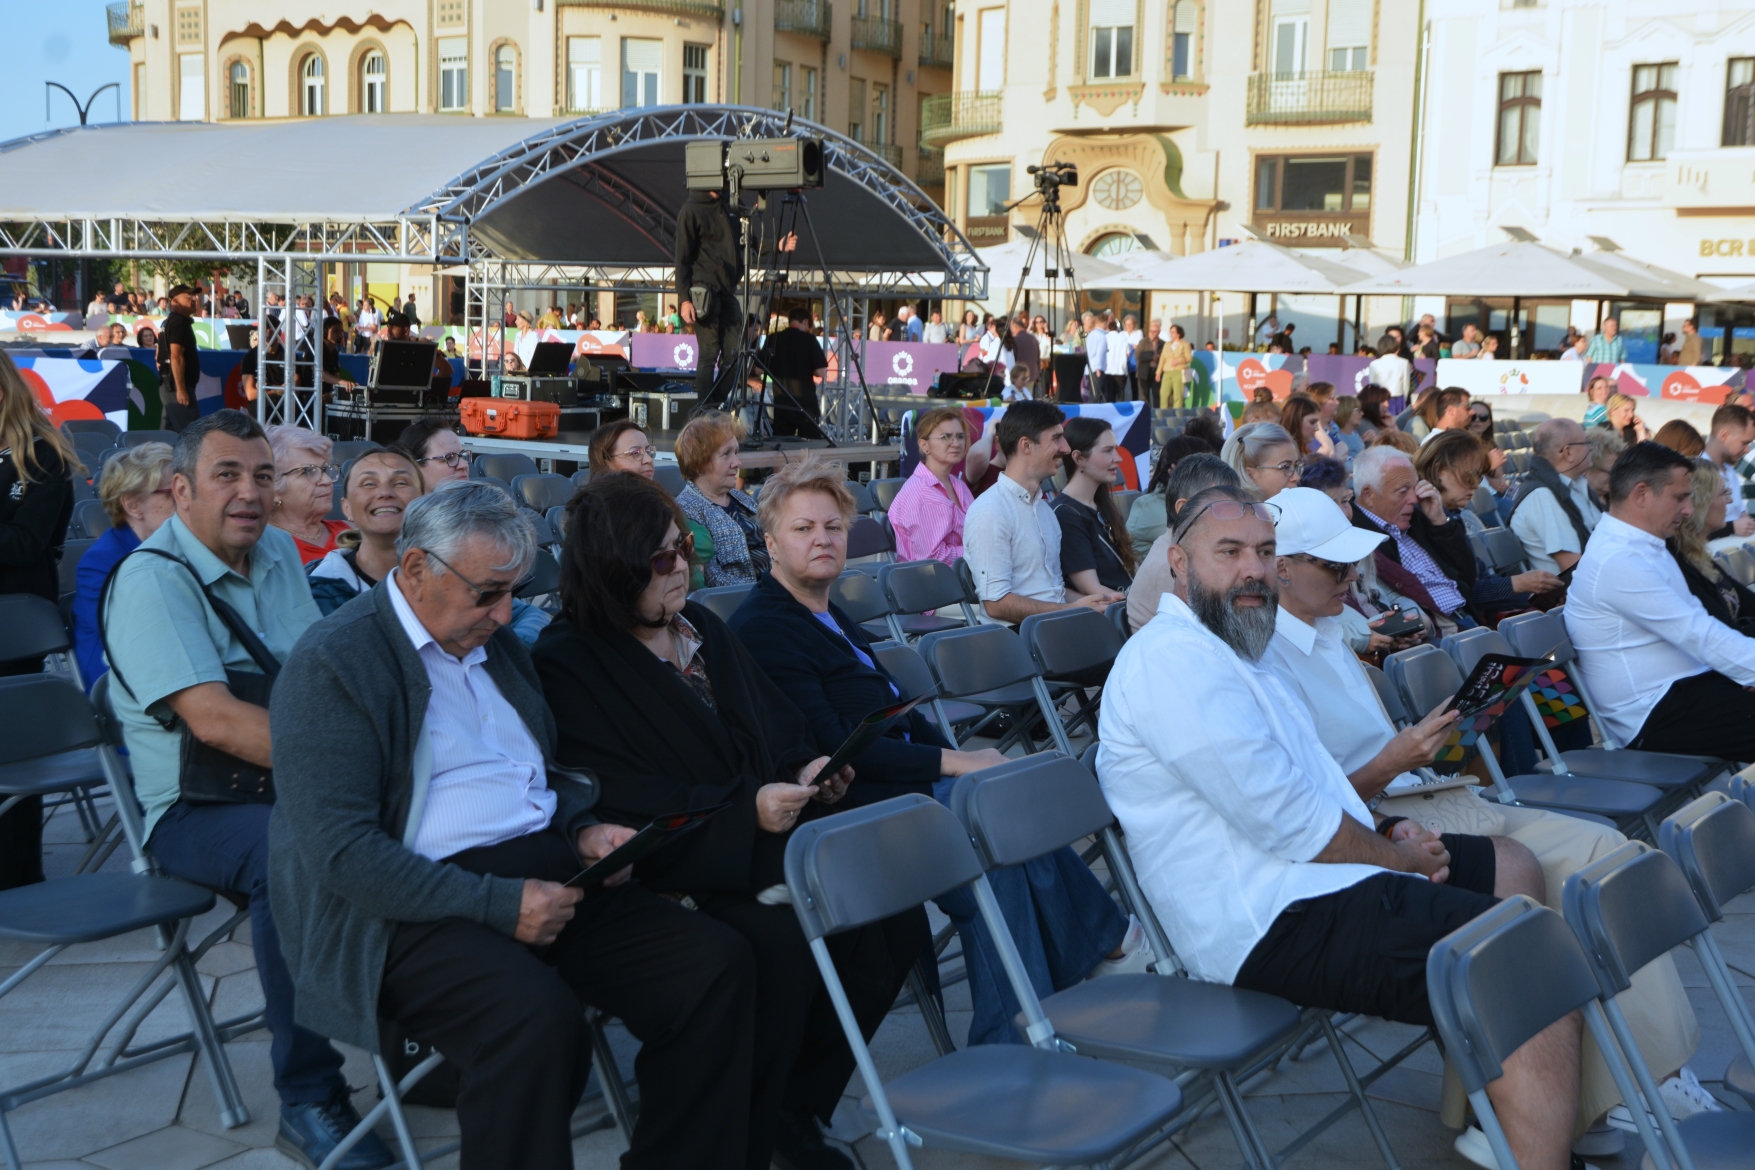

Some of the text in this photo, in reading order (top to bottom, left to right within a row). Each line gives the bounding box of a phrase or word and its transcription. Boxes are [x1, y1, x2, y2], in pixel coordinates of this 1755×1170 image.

[967, 226, 1005, 236] FIRSTBANK
[1266, 222, 1352, 238] FIRSTBANK
[1699, 239, 1743, 257] BCR
